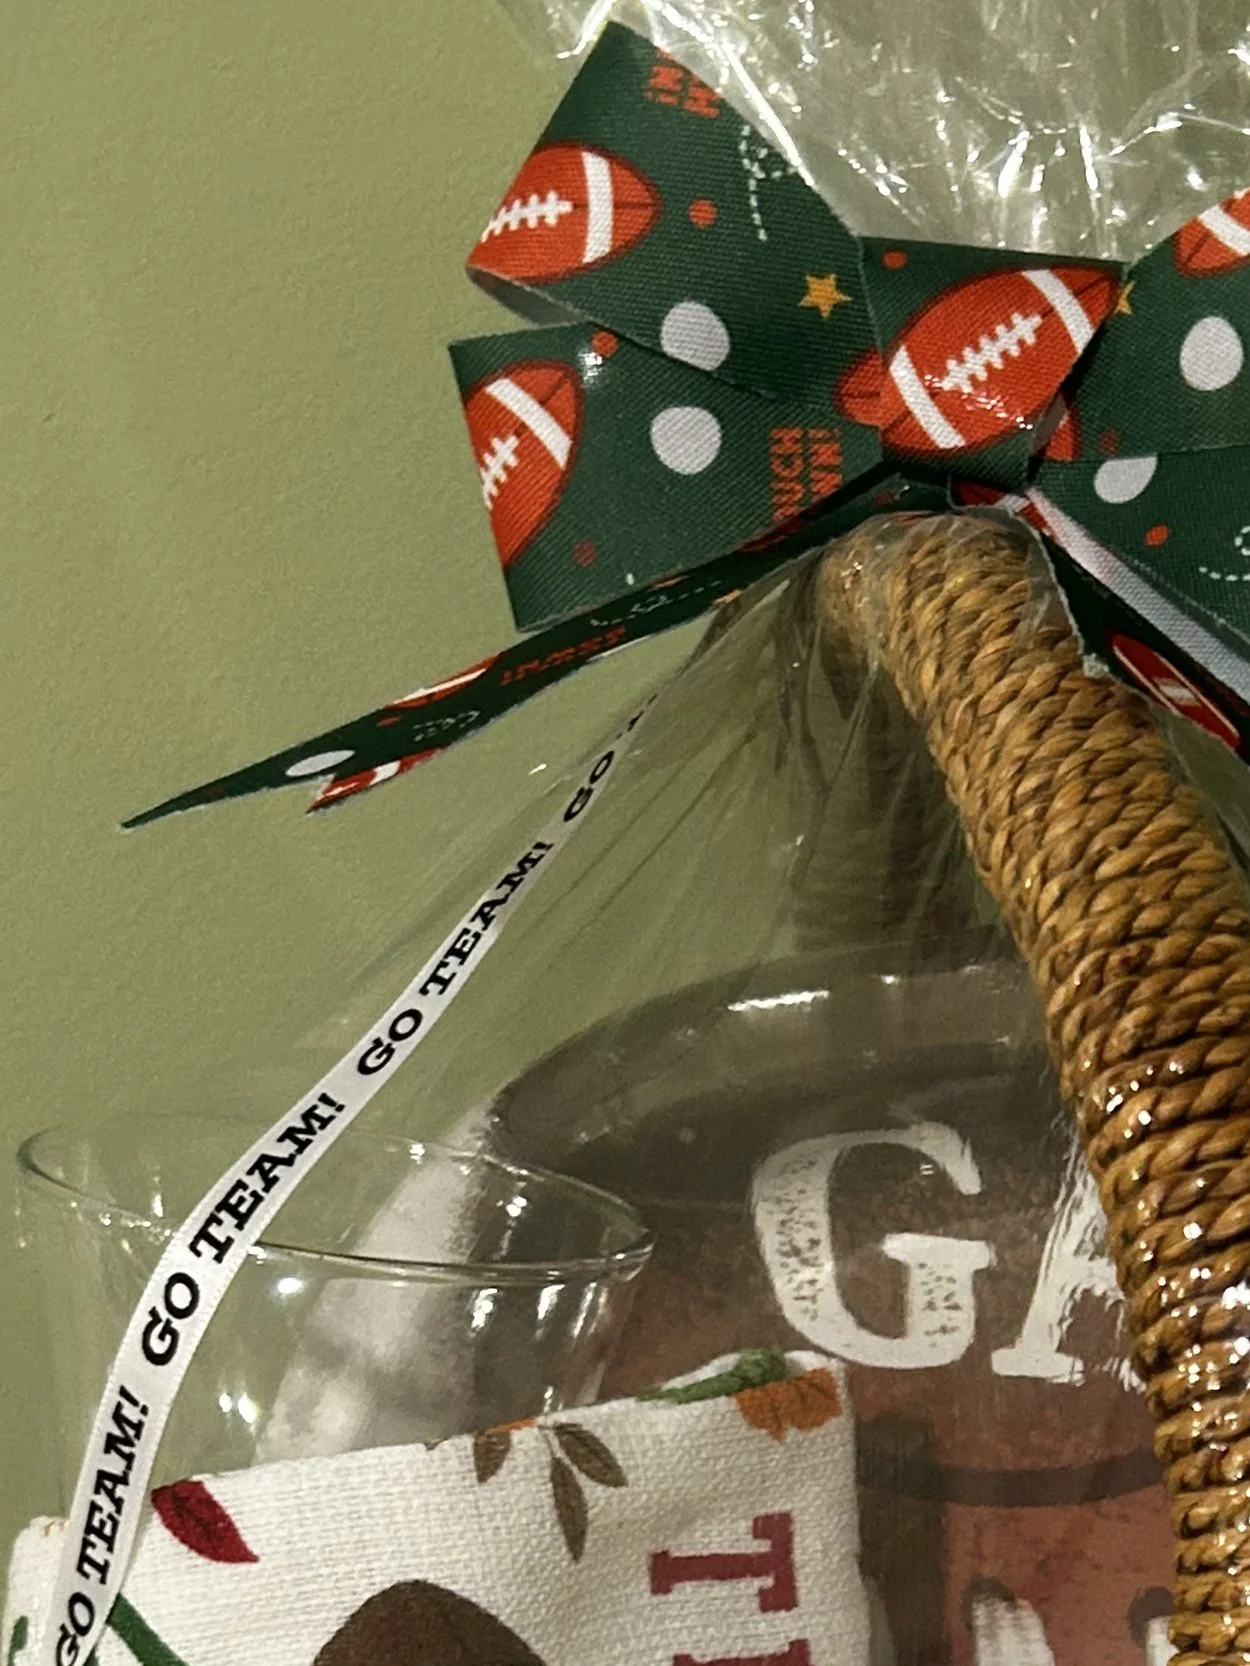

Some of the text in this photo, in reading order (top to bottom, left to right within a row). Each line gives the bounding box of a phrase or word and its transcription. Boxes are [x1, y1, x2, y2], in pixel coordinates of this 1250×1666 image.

[76, 1384, 149, 1585] TEAM!
[141, 1271, 199, 1367] GO
[188, 1092, 346, 1264] TEAM!
[356, 1007, 424, 1076] GO
[418, 840, 555, 999] TEAM!
[562, 750, 615, 823] GO
